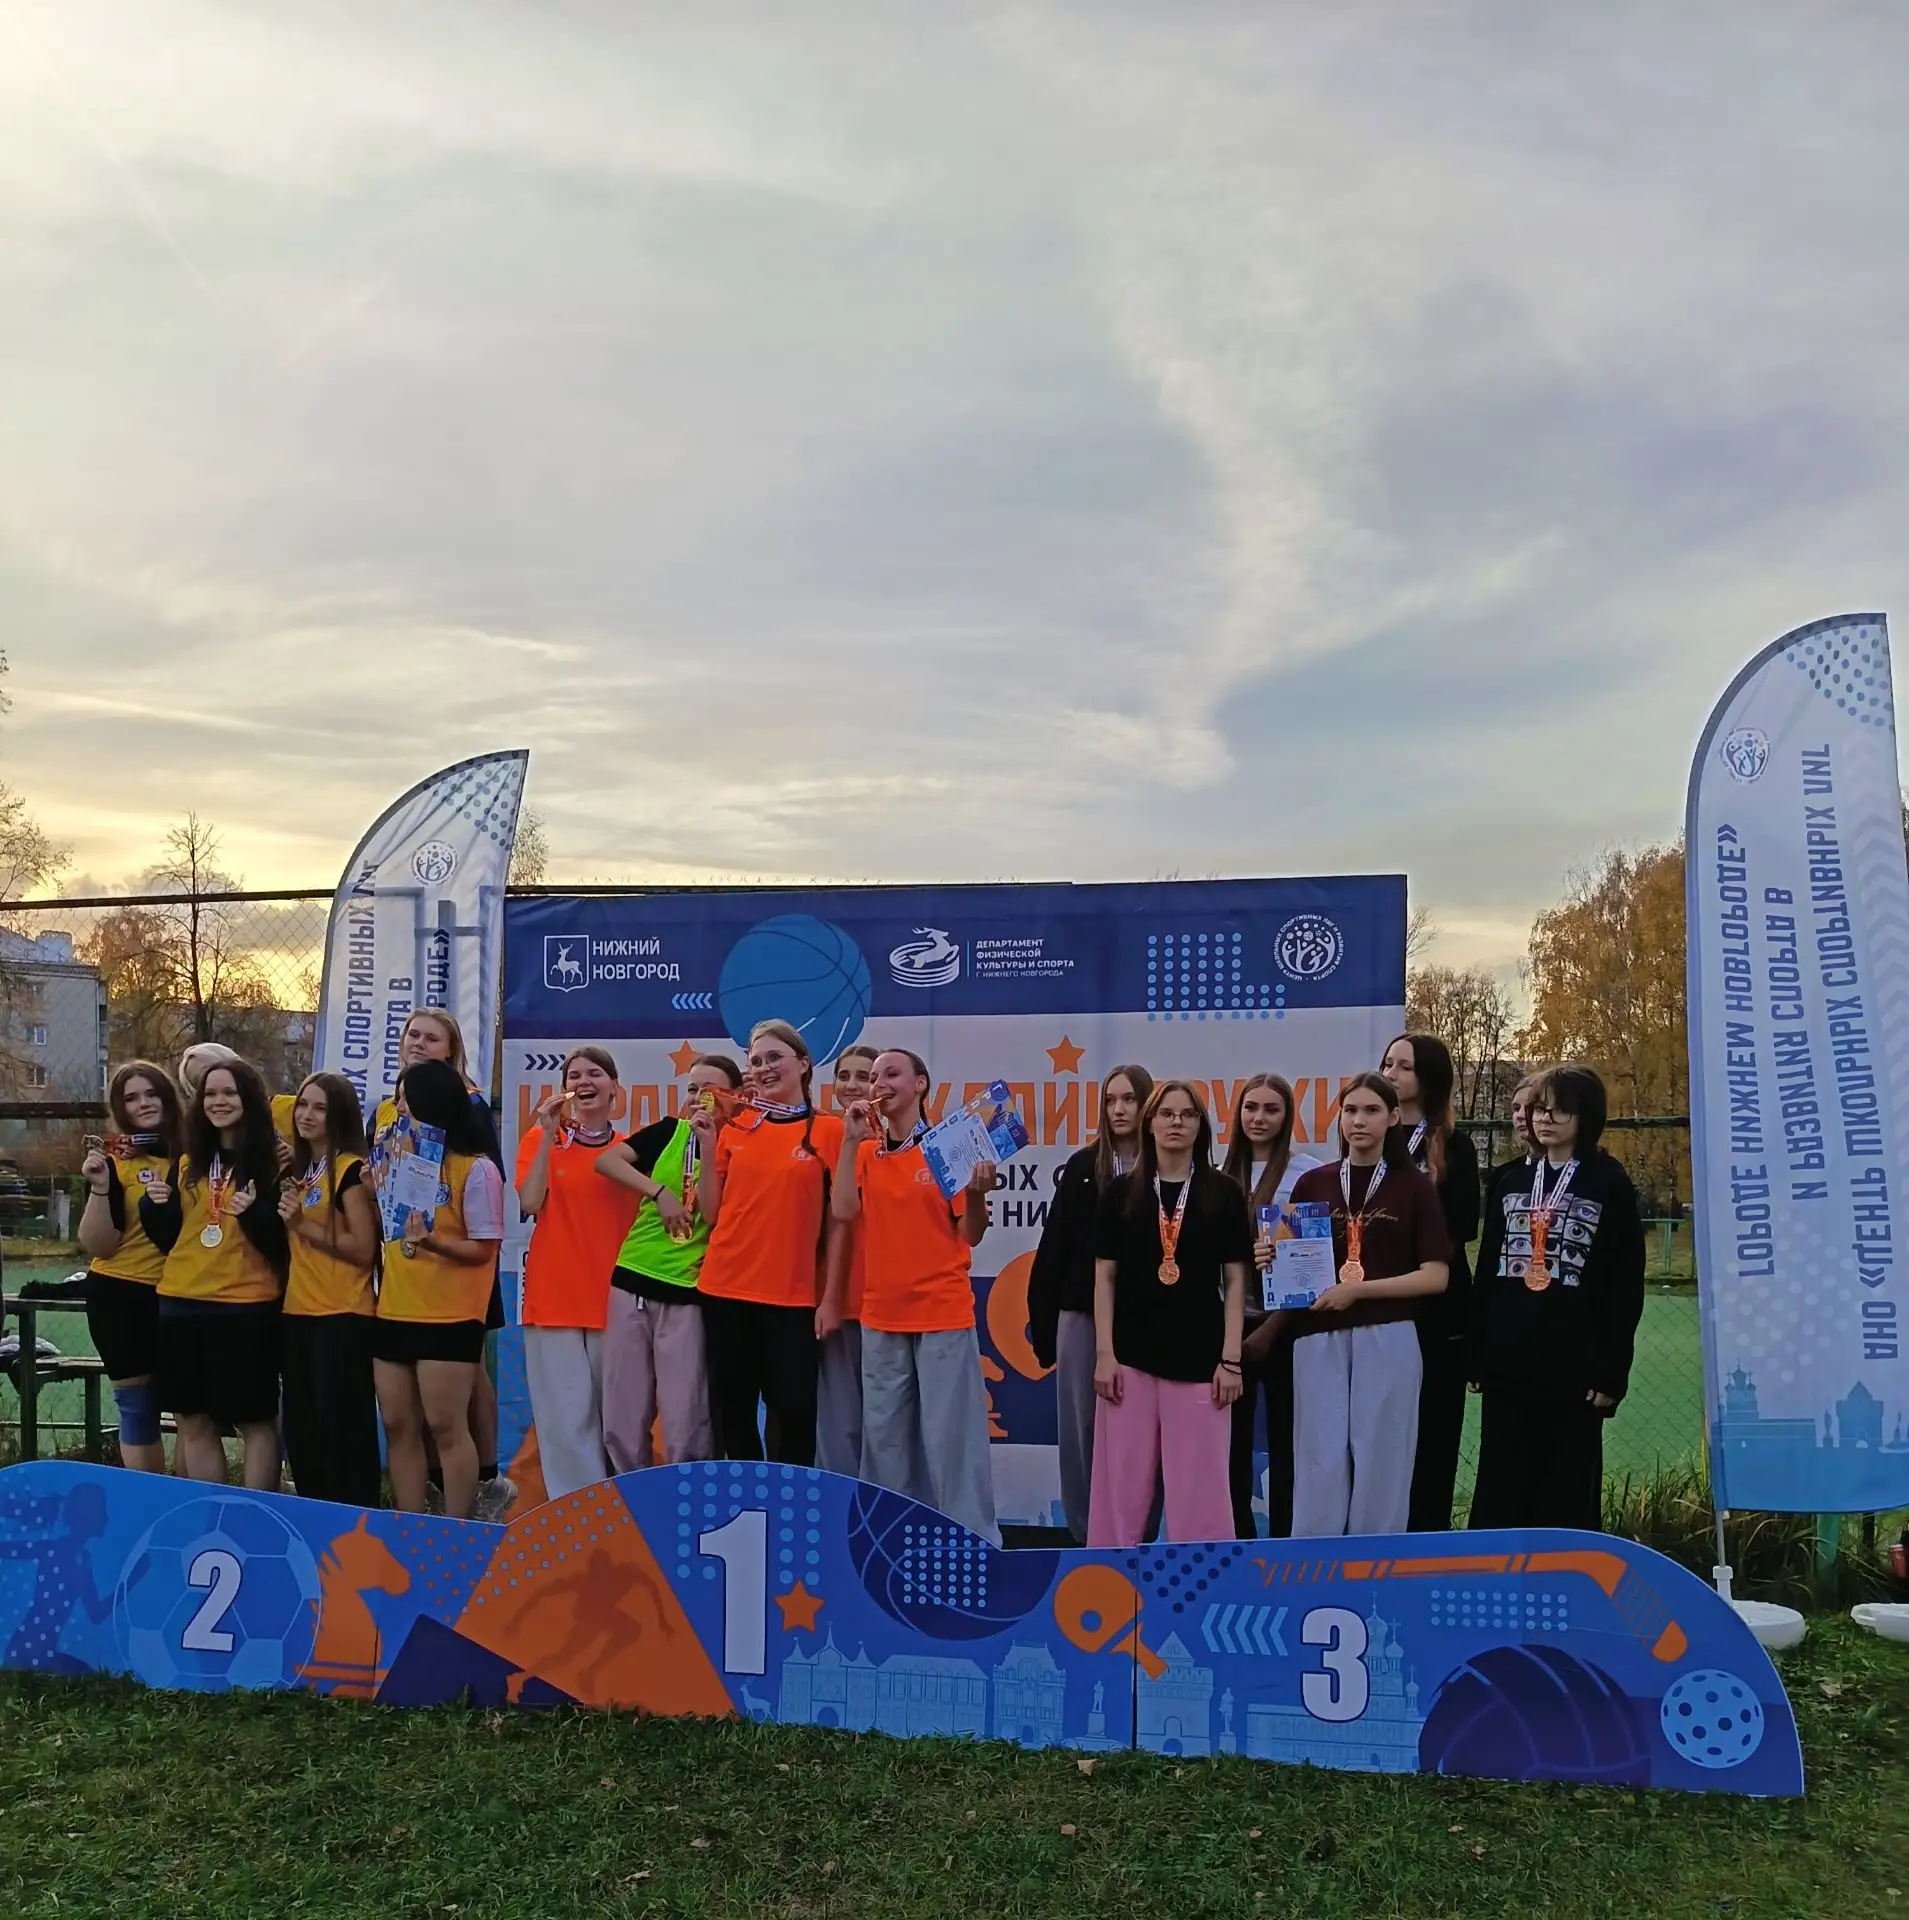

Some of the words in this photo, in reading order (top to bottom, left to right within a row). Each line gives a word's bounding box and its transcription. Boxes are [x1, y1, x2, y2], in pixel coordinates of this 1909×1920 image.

[592, 936, 660, 956] НИЖНИЙ
[976, 939, 1044, 949] ДЕПАРТАМЕНТ
[976, 948, 1041, 959] ФИЗИЧЕСКОЙ
[426, 928, 450, 1010] РОДЕ»
[592, 963, 680, 982] НОВГОРОД
[976, 961, 1026, 970] КУЛЬТУРЫ
[1028, 961, 1036, 970] И
[1037, 960, 1075, 968] СПОРТА
[982, 970, 1019, 978] НИЖНЕГО
[343, 897, 375, 1060] СПОРТИВНЫХ
[388, 977, 413, 991] В
[181, 1550, 245, 1653] 2
[698, 1509, 769, 1677] 1
[1301, 1606, 1371, 1723] 3
